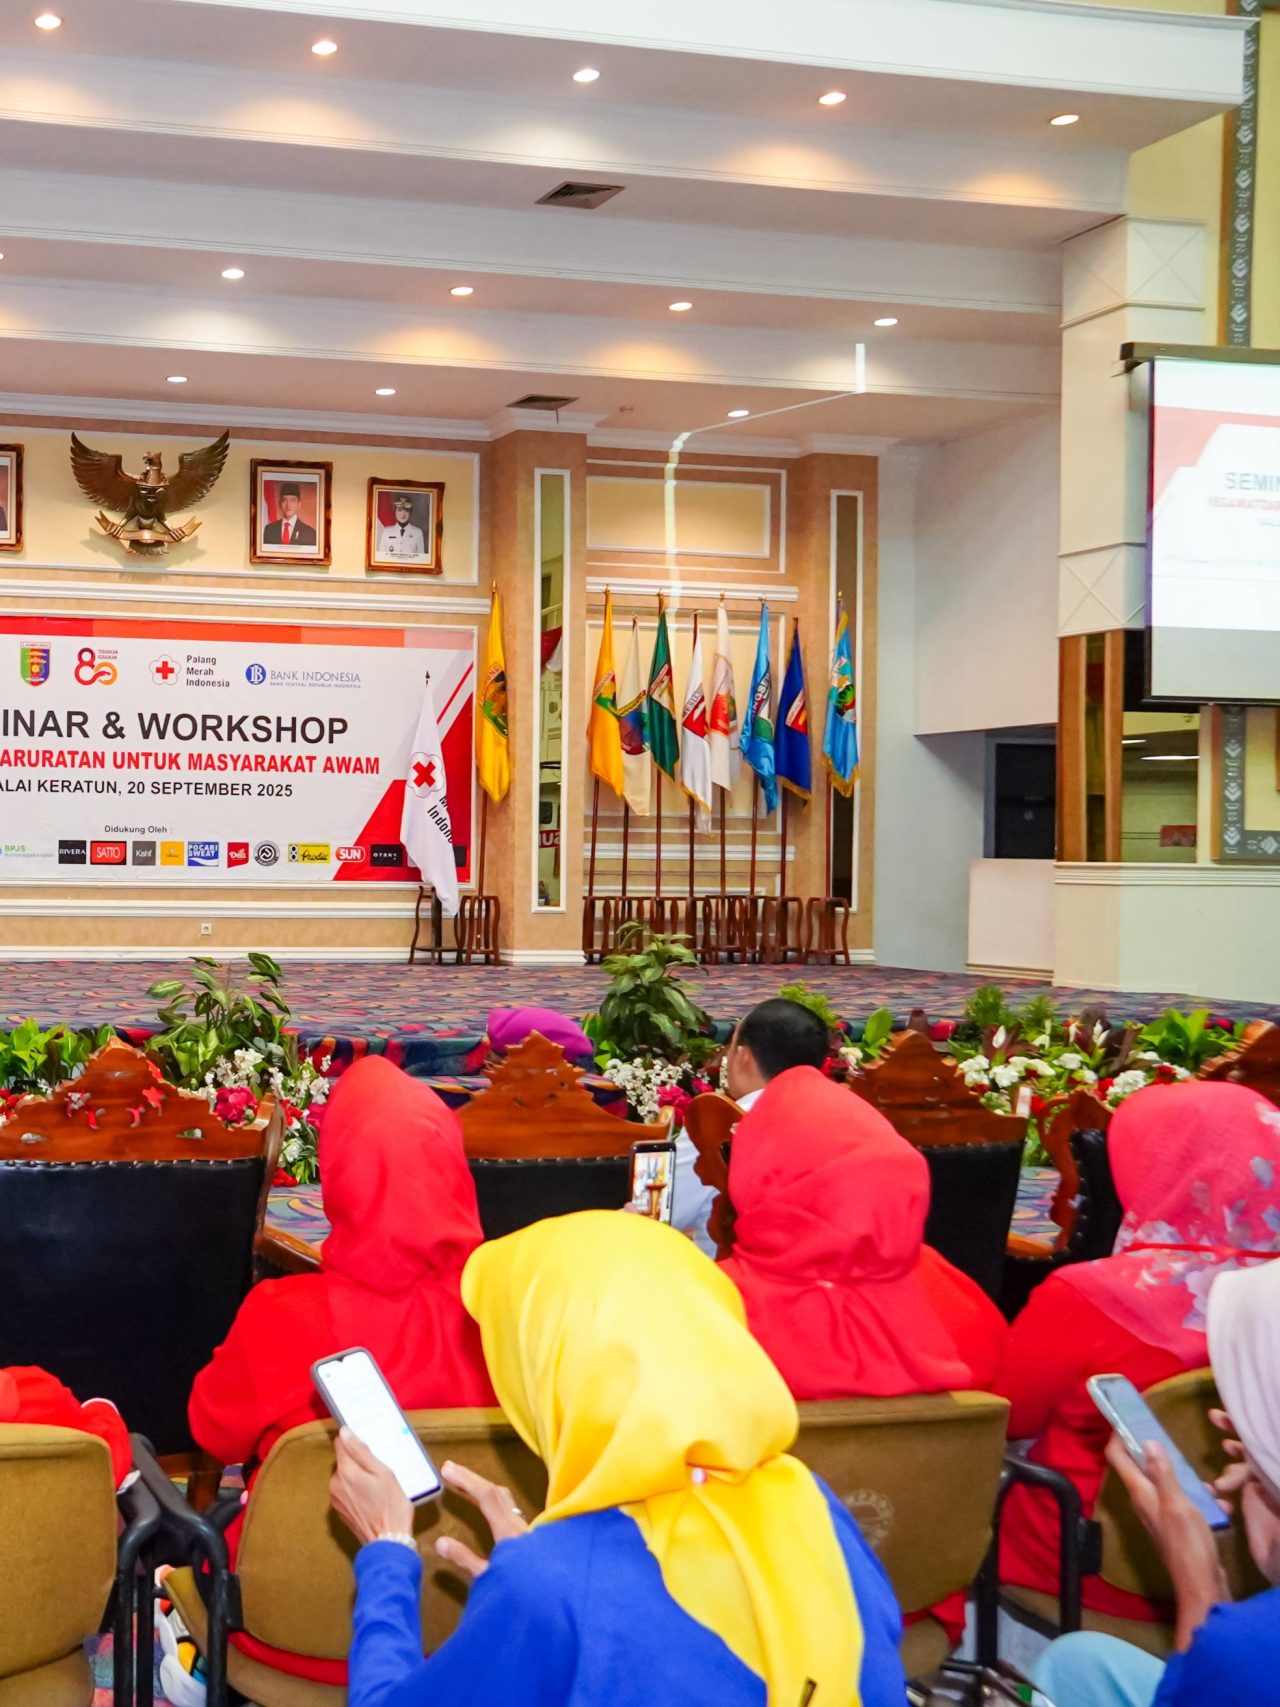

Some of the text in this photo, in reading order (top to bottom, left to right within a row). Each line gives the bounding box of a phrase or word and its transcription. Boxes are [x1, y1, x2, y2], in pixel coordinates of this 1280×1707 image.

[186, 655, 217, 666] Palang
[186, 667, 214, 676] Merah
[270, 670, 361, 683] BANK INDONESIA
[186, 679, 230, 687] Indonesia
[102, 710, 126, 739] &
[138, 712, 348, 744] WORKSHOP
[113, 751, 181, 771] UNTUK
[188, 752, 316, 774] MASYARAKAT
[323, 757, 380, 775] AWAM
[37, 779, 122, 796] KERATUN,
[127, 781, 146, 795] 20
[150, 781, 252, 797] SEPTEMBER
[257, 783, 293, 797] 2025
[104, 825, 146, 835] Didukung
[148, 825, 168, 834] Oleh
[4, 844, 26, 852] BPJS
[59, 848, 87, 856] RIVERA
[96, 847, 121, 859] SATTO
[338, 848, 362, 860] SUN
